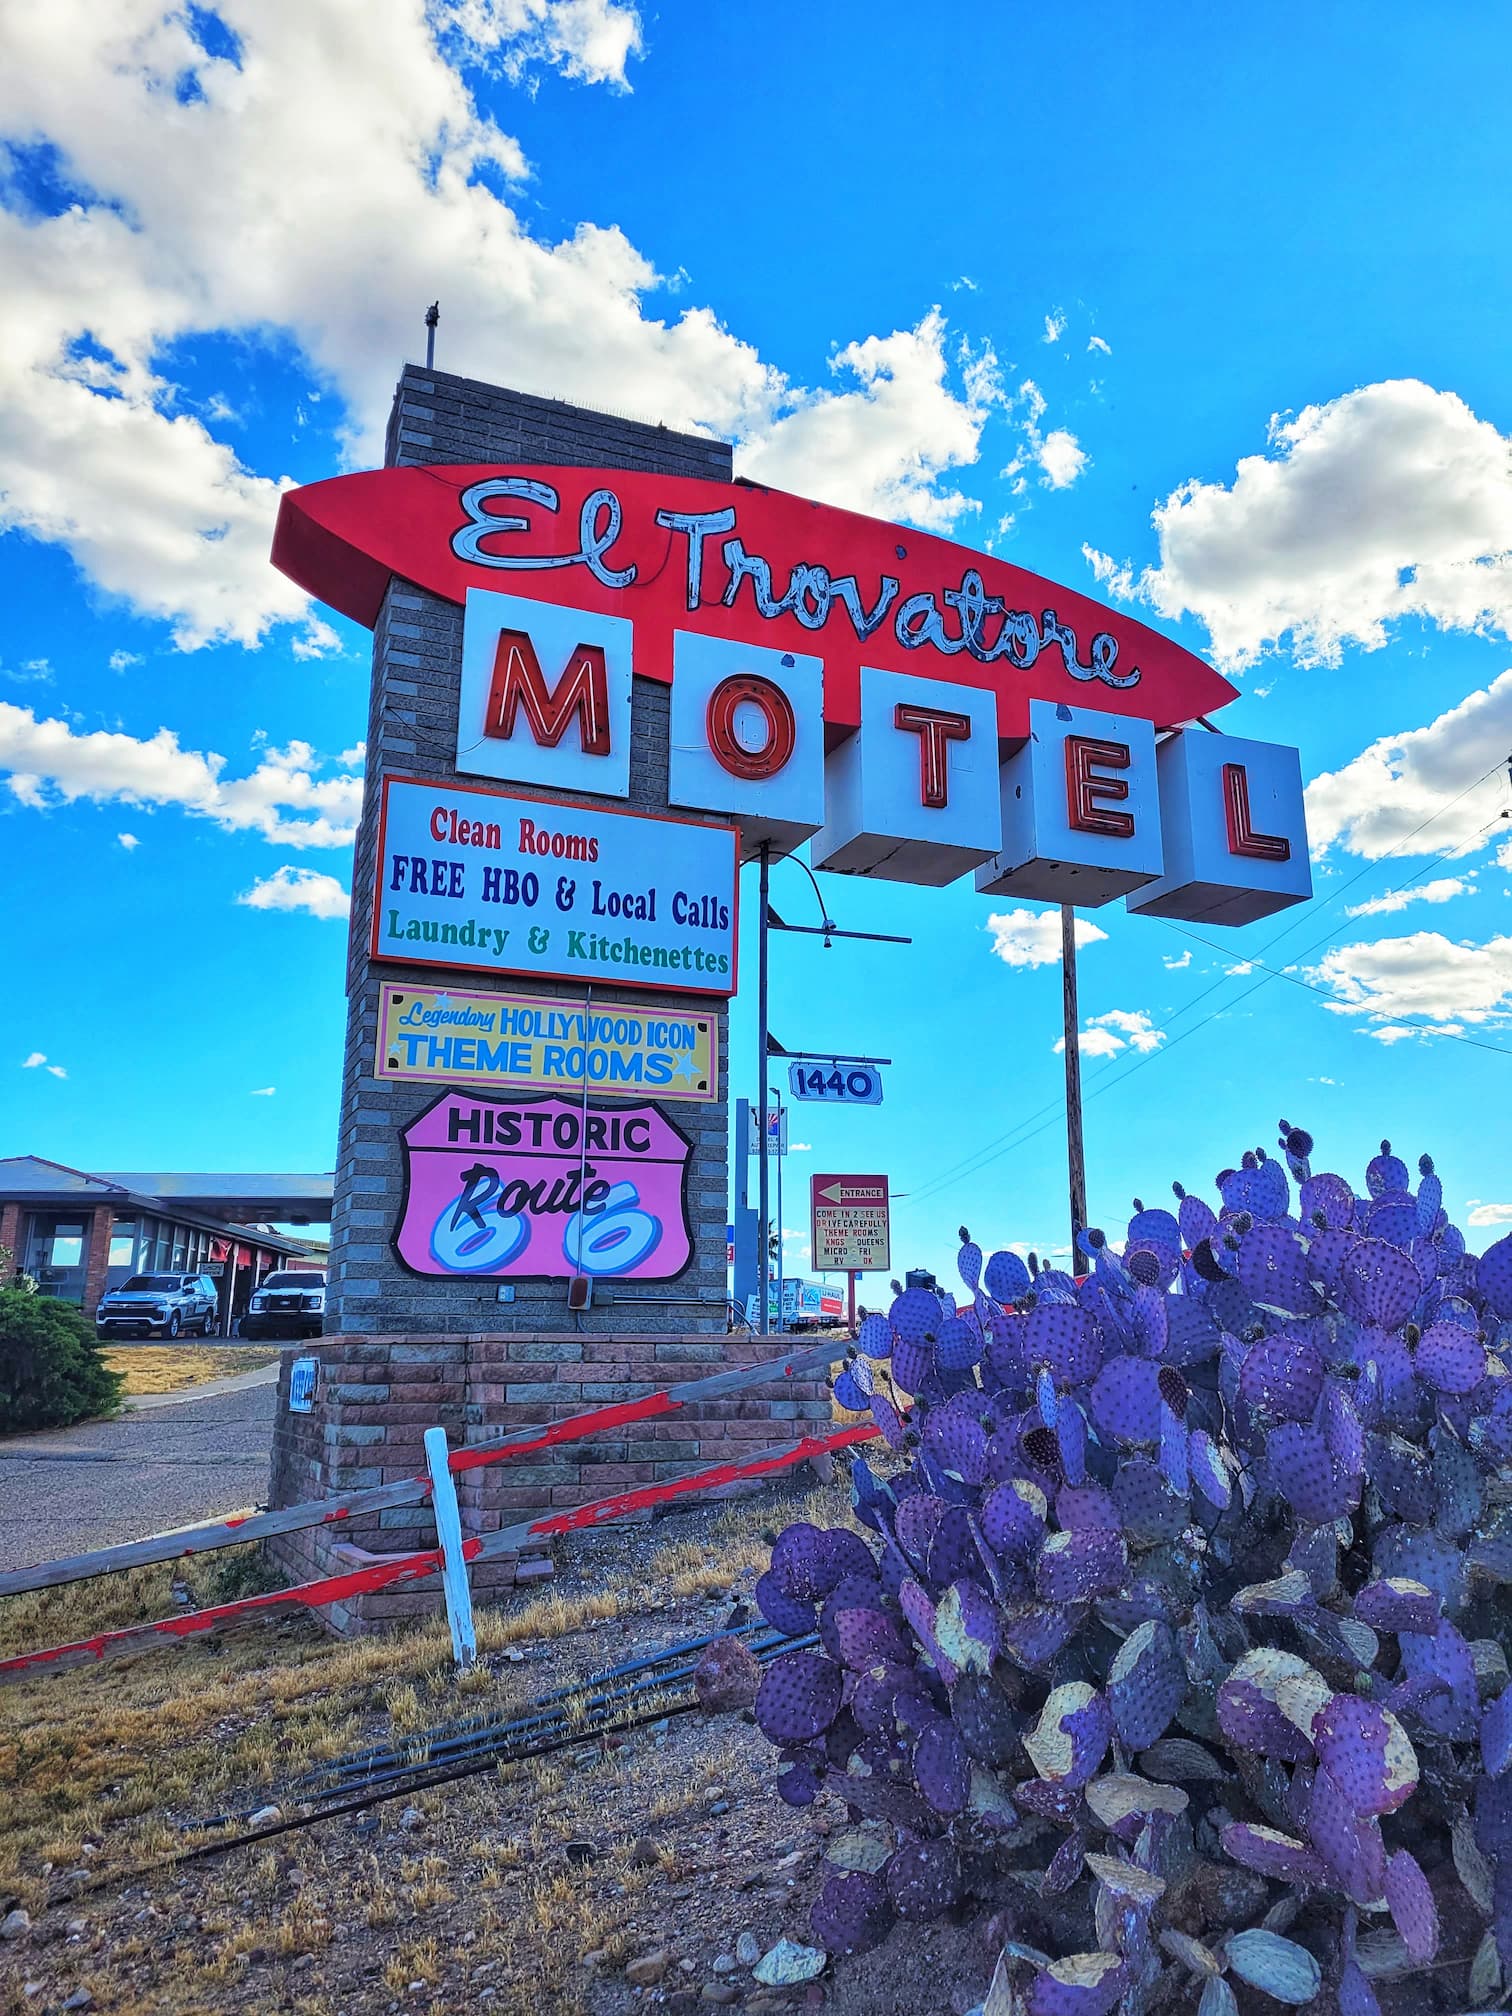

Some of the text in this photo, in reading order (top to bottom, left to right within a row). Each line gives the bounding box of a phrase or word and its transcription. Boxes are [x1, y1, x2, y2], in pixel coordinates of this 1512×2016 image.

[449, 476, 1142, 689] El Trovatore
[483, 628, 1292, 862] MOTEL
[429, 806, 600, 863] Clean Rooms
[389, 854, 730, 931] FREE HBO & Local Calls
[387, 909, 729, 974] Laundry & Kitchenettes
[399, 1001, 696, 1050] Legendary HOLLYWOOD ICON
[398, 1033, 674, 1085] THEME ROOMS
[797, 1067, 873, 1098] 1440
[447, 1107, 652, 1153] HISTORIC
[450, 1161, 611, 1233] Route
[816, 1210, 886, 1218] COME IN 2 SEE US
[840, 1189, 881, 1197] ENTRANCE
[430, 1179, 663, 1276] 66
[824, 1229, 849, 1237] THEME
[843, 1220, 887, 1228] CAREFULLY
[823, 1247, 848, 1256] MICRO
[859, 1247, 871, 1256] FRI
[834, 1257, 844, 1265] RV
[863, 1257, 873, 1265] OK
